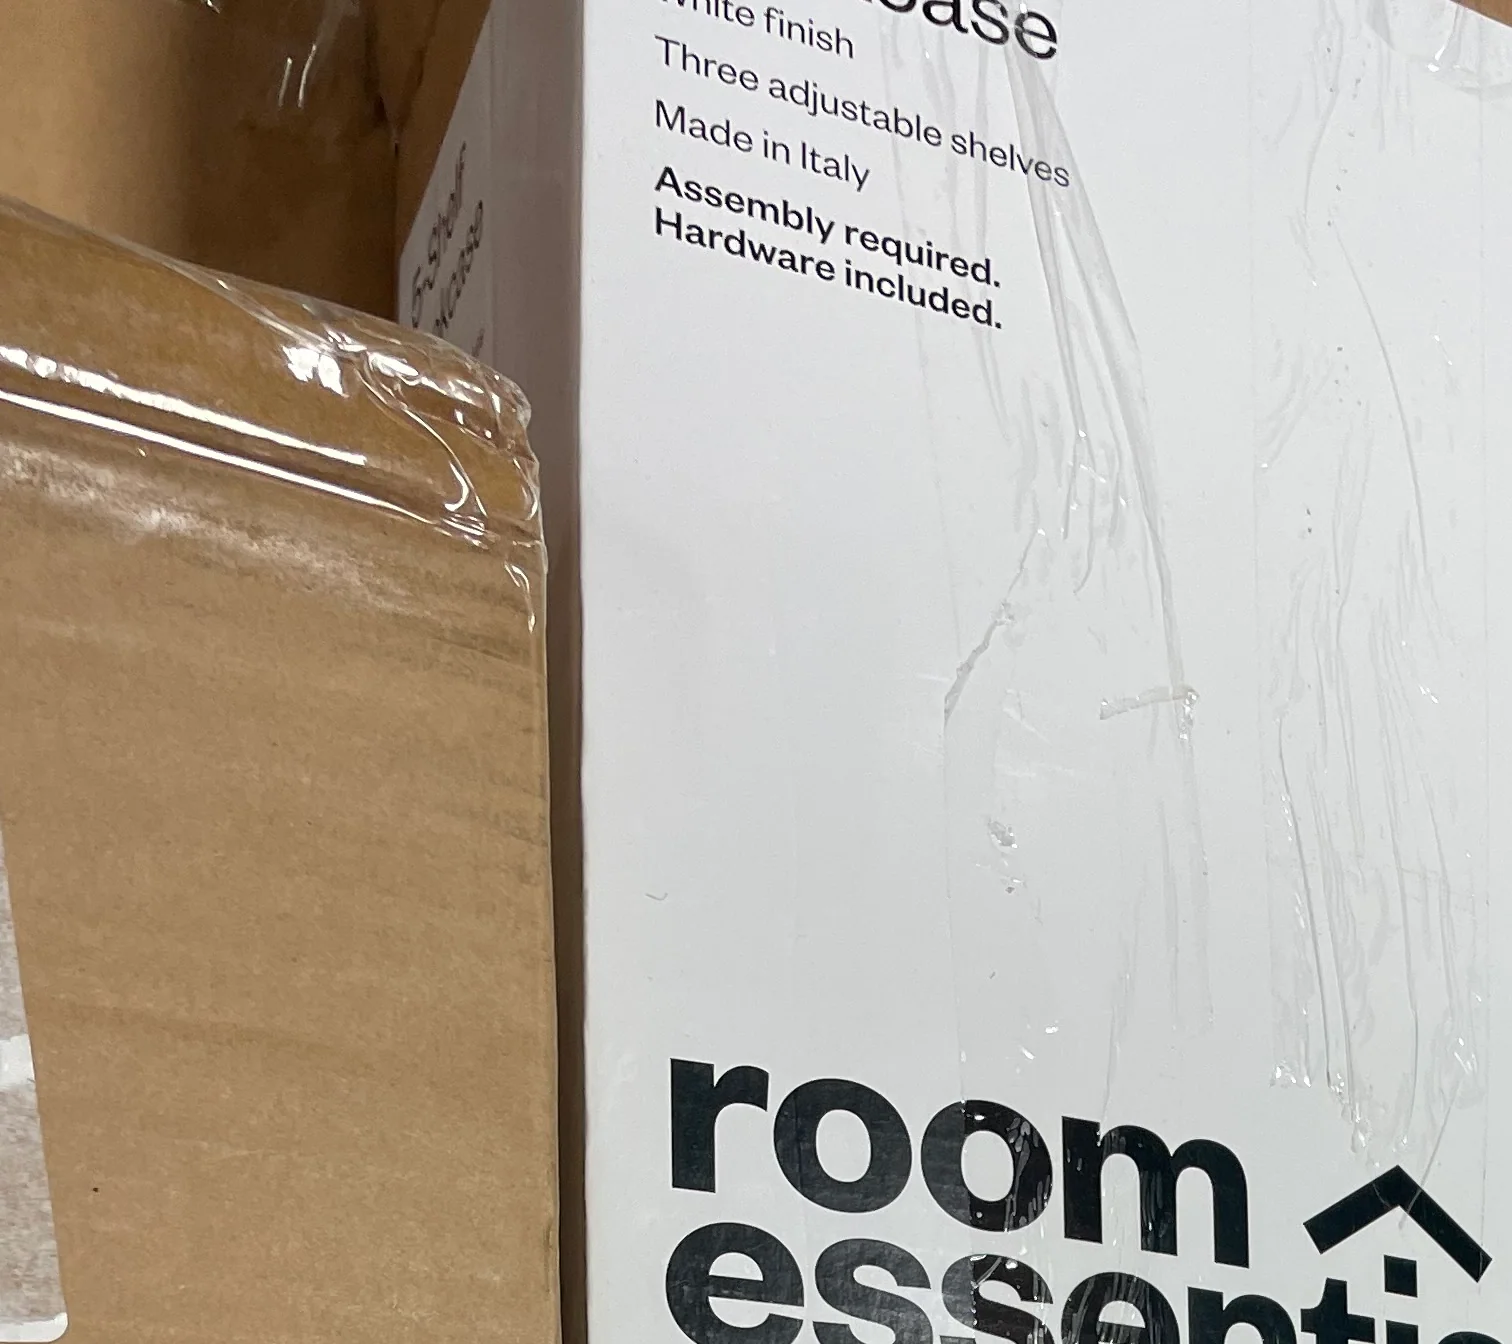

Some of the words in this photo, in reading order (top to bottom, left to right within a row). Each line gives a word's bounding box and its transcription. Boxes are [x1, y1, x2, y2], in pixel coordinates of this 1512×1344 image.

[764, 8, 856, 59] finish
[868, 0, 1058, 61] ase
[654, 34, 760, 92] Three
[768, 76, 943, 149] adjustable
[951, 128, 1071, 189] shelves
[654, 99, 754, 154] Made
[763, 128, 791, 166] in
[800, 140, 871, 193] Italy
[654, 165, 836, 245] Assembly
[844, 221, 1002, 289] required.
[654, 206, 837, 281] Hardware
[844, 258, 1003, 330] included.
[668, 1057, 1250, 1269] room
